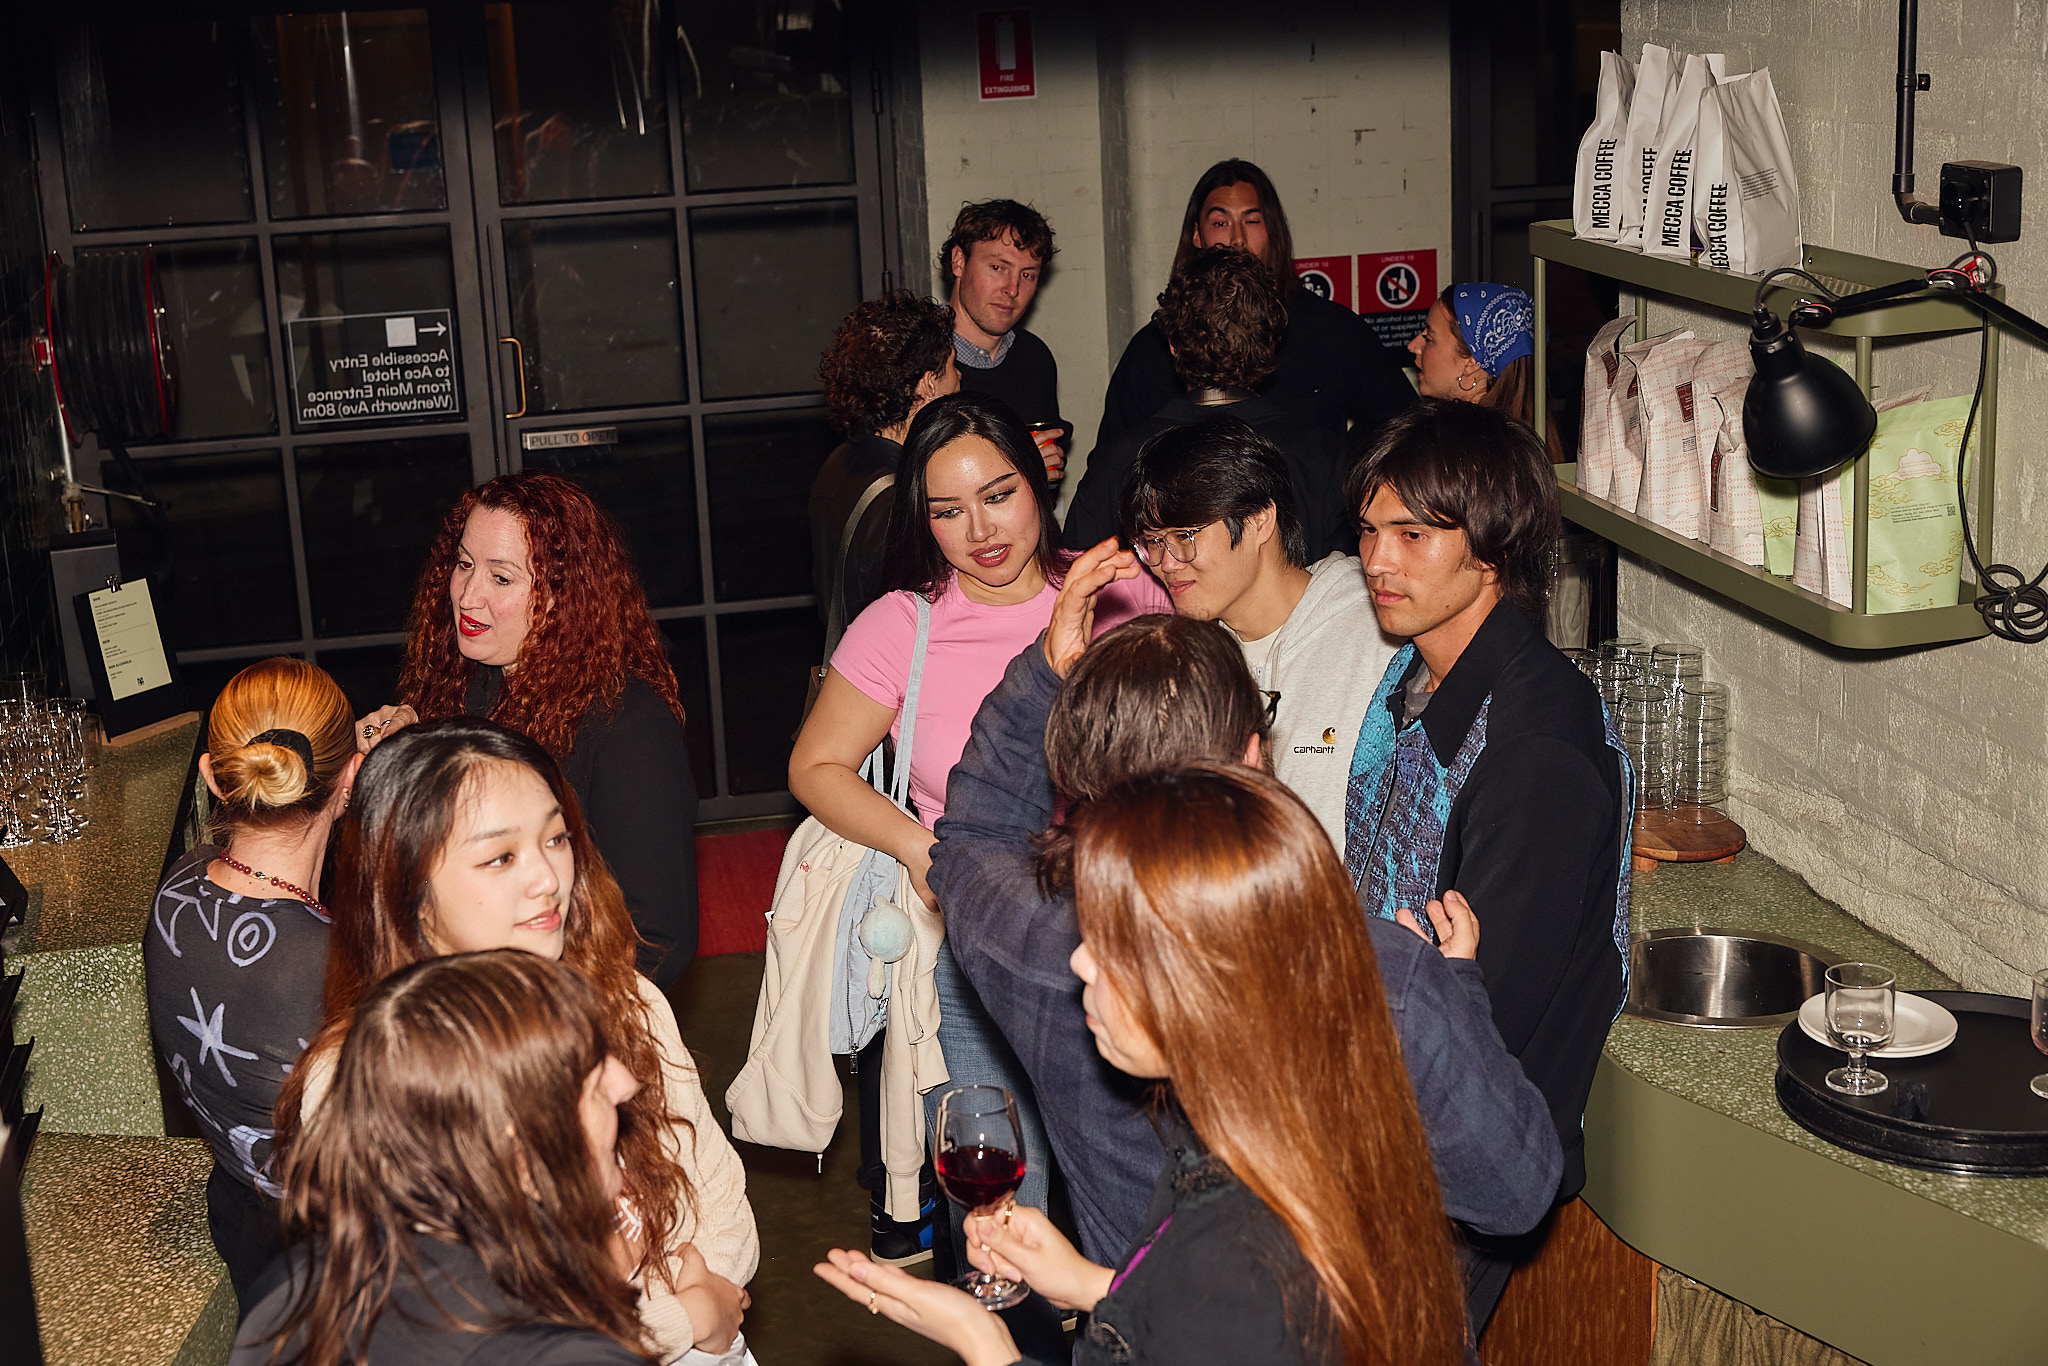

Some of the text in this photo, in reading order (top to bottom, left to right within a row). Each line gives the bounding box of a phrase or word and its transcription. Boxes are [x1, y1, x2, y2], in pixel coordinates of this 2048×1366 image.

[1591, 138, 1618, 229] MECCA COFFEE
[1661, 149, 1692, 247] MECCA COFFEE
[1707, 182, 1730, 270] ECCA COFFEE
[531, 430, 615, 446] PULL TO OPEN
[1294, 746, 1335, 754] carhartt
